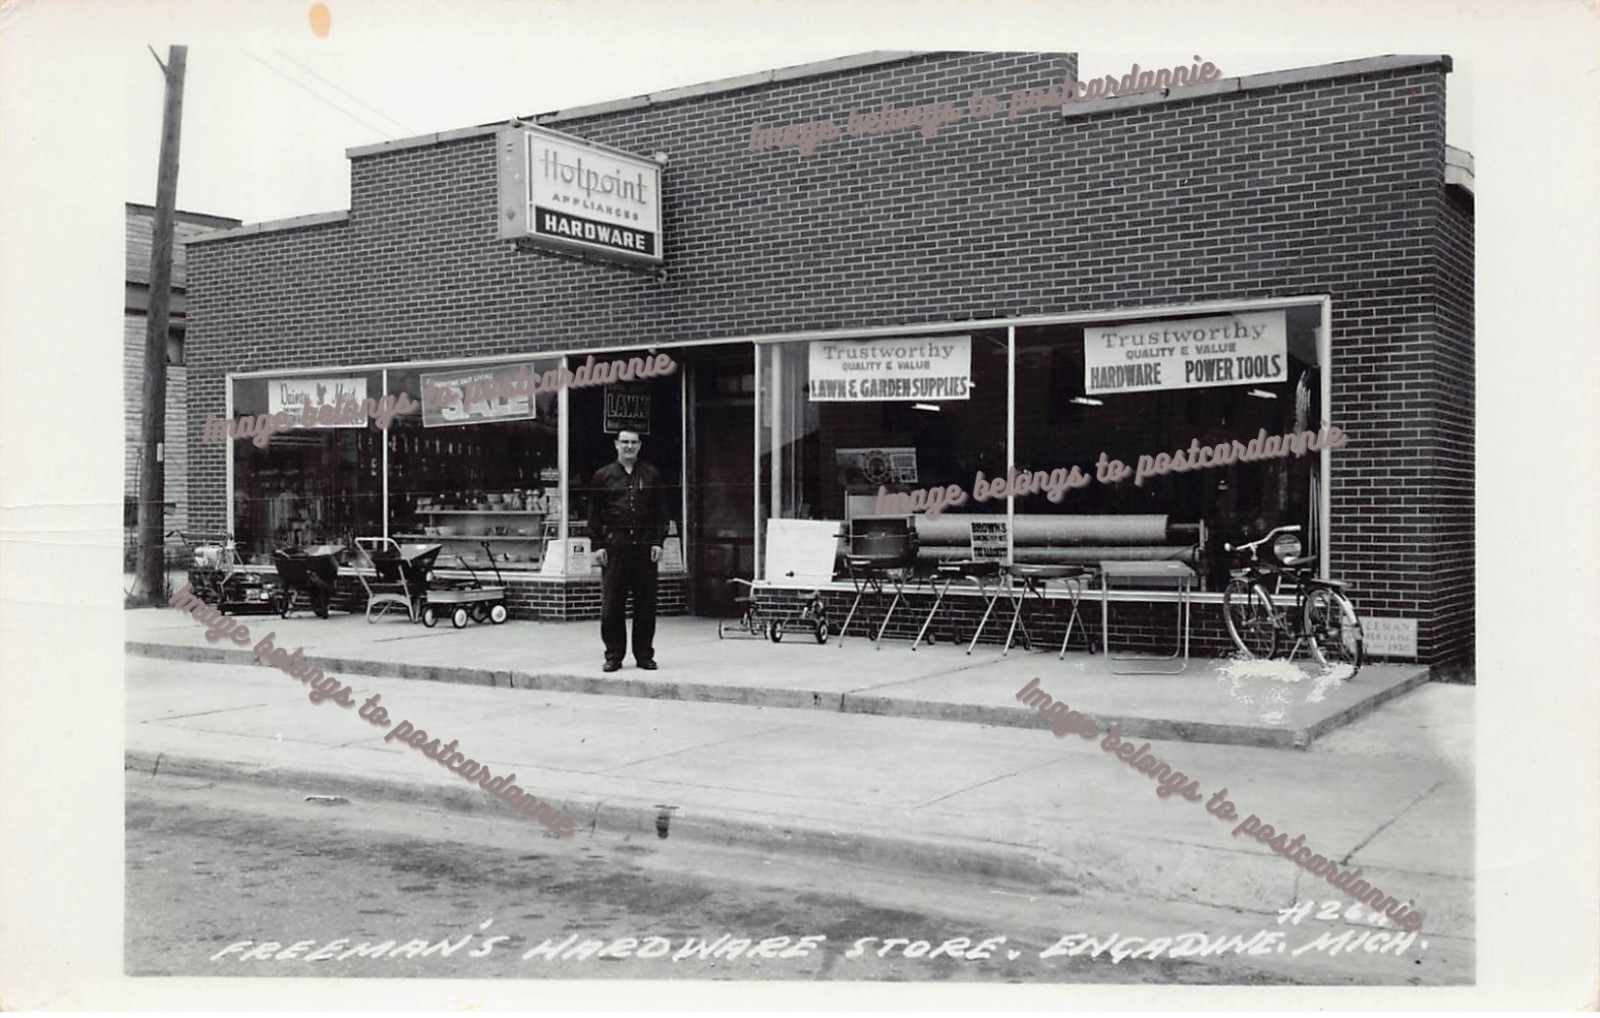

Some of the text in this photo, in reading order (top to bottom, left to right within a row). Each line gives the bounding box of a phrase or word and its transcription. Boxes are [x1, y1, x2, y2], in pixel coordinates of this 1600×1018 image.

[540, 148, 648, 205] Hotpoint
[545, 214, 646, 250] HARDWARE
[1101, 321, 1267, 348] Trustworthy
[823, 342, 955, 361] Trustworthy
[1126, 346, 1176, 360] QUALITY
[1195, 342, 1237, 355] VALUE
[842, 361, 882, 371] QUALITY
[899, 360, 931, 371] VALUE
[1090, 353, 1281, 389] HARDWARE POWER TOOLS
[811, 379, 846, 399] LAWN
[860, 378, 911, 399] GARDEN
[912, 376, 968, 398] SUPPLIES
